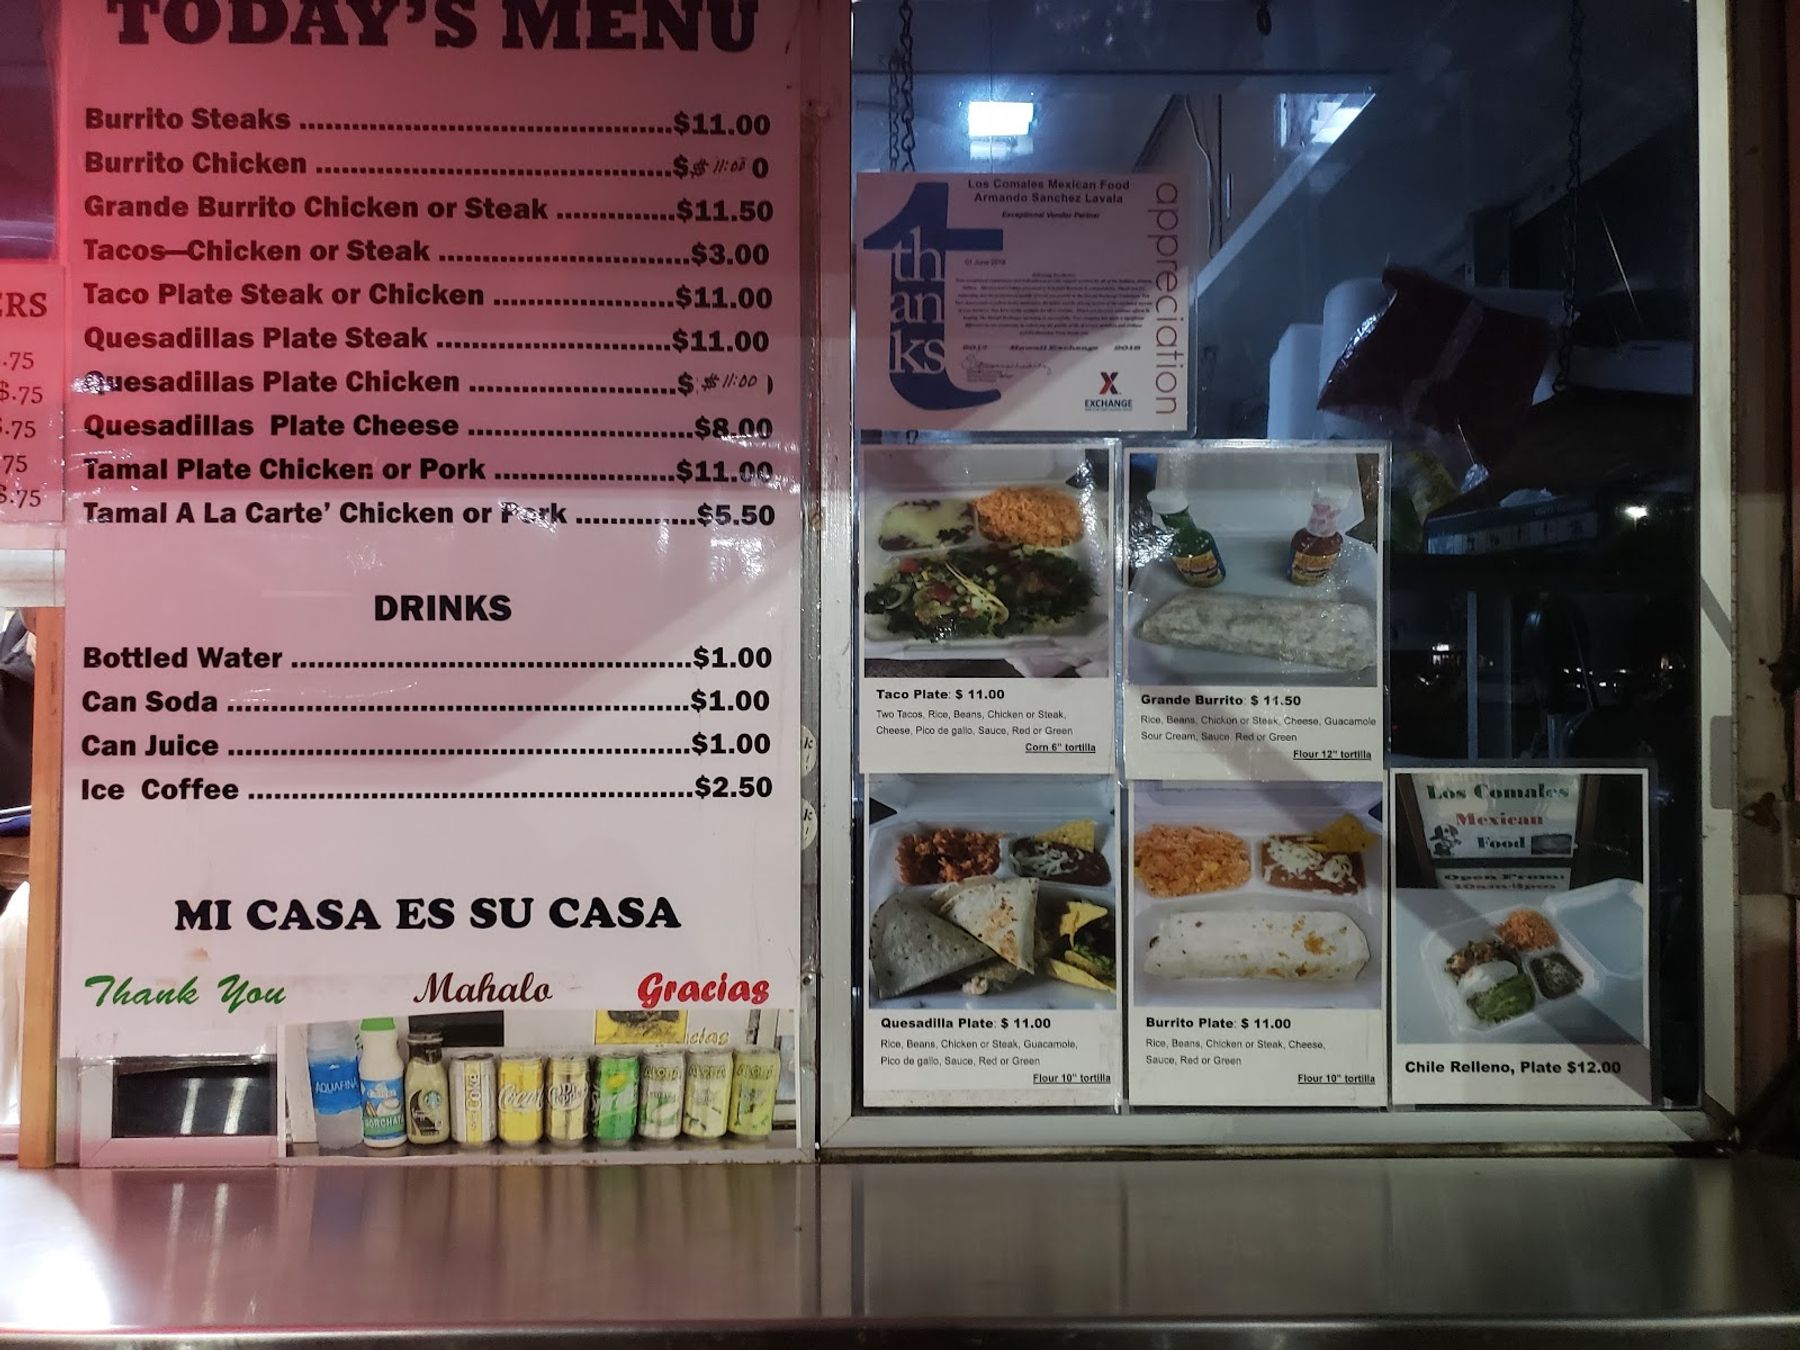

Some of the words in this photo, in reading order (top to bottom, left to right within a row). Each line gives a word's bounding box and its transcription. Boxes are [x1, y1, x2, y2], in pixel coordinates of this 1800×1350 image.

[502, 0, 758, 52] MENU
[85, 108, 183, 130] Burrito
[191, 108, 291, 130] Steaks
[673, 111, 771, 137] $11.00
[85, 152, 184, 173] Burrito
[192, 152, 306, 174] Chicken
[968, 179, 989, 189] Los
[993, 179, 1044, 189] Comales
[1048, 179, 1096, 190] Mexican
[1100, 180, 1130, 190] Food
[974, 192, 1027, 203] Armando
[1032, 193, 1080, 203] Sanchez
[84, 196, 189, 218] Grande
[199, 196, 295, 217] Burrito
[304, 197, 418, 218] Chicken
[428, 203, 457, 219] or
[465, 198, 548, 219] Steak
[676, 198, 773, 223] $11.50
[310, 246, 338, 261] or
[347, 240, 430, 262] Steak
[691, 242, 769, 266] $3.00
[84, 283, 149, 304] Taco
[158, 283, 232, 304] Plate
[240, 283, 323, 304] Steak
[331, 289, 361, 304] or
[369, 284, 484, 305] Chicken
[676, 285, 772, 309] $11.00
[1147, 182, 1184, 415] appreciation
[84, 326, 254, 351] Quesadillas
[263, 327, 337, 348] Plate
[345, 327, 427, 348] Steak
[672, 329, 769, 353] $11.00
[84, 370, 254, 395] Quesadillas
[263, 371, 337, 392] Plate
[346, 371, 459, 392] Chicken
[1084, 399, 1133, 409] EXCHANGE
[84, 414, 254, 439] Quesadillas
[271, 415, 344, 436] Plate
[353, 415, 459, 436] Cheese
[695, 415, 773, 440] $8.00
[84, 458, 167, 480] Tamal
[177, 458, 250, 480] Plate
[260, 458, 373, 480] Chicken
[383, 464, 412, 480] or
[420, 458, 486, 480] Pork
[676, 459, 773, 483] $11.00
[84, 502, 166, 524] Tamal
[176, 503, 194, 524] A
[205, 503, 236, 524] La
[340, 502, 453, 524] Chicken
[463, 509, 492, 524] or
[697, 504, 775, 528] $5.50
[374, 595, 512, 621] DRINKS
[84, 647, 188, 668] Bottled
[197, 647, 282, 668] Water
[693, 645, 772, 669] $1.00
[82, 691, 136, 712] Can
[145, 691, 217, 712] Soda
[690, 689, 769, 713] $1.00
[876, 689, 909, 699] Taco
[955, 689, 963, 700] $
[968, 689, 1005, 699] 11.00
[1141, 694, 1190, 705] Grande
[1251, 694, 1259, 706] $
[1264, 695, 1301, 706] 11.50
[876, 710, 894, 719] Two
[988, 710, 1023, 719] Chicken
[1201, 716, 1237, 725] Chicken
[1325, 717, 1376, 726] Guacamole
[82, 735, 136, 756] Can
[145, 734, 219, 756] Juice
[691, 731, 770, 756] $1.00
[1025, 743, 1048, 751] Corn
[1065, 743, 1096, 751] tortilla
[1293, 750, 1318, 759] Flour
[1340, 750, 1371, 759] tortilla
[82, 779, 124, 800] Ice
[141, 778, 239, 800] Coffee
[695, 774, 772, 799] $2.50
[1427, 785, 1466, 800] Los
[1474, 783, 1569, 799] Comales
[1456, 812, 1543, 825] Mexican
[1477, 836, 1525, 849] Food
[175, 899, 231, 930] MI
[246, 899, 381, 929] CASA
[396, 898, 455, 929] ES
[470, 898, 534, 928] SU
[549, 897, 681, 928] CASA
[85, 975, 199, 1006] Thank
[217, 974, 286, 1013] You
[413, 972, 553, 1003] Mahalo
[637, 972, 770, 1008] Gracias
[881, 1018, 953, 1029] Quesadilla
[1001, 1018, 1009, 1029] $
[1015, 1018, 1051, 1028] 11.00
[1146, 1017, 1194, 1028] Burrito
[1241, 1018, 1249, 1029] $
[1254, 1018, 1291, 1029] 11.00
[881, 1057, 900, 1065] Pico
[903, 1057, 914, 1065] de
[979, 1057, 997, 1065] Red
[1012, 1057, 1040, 1066] Green
[1181, 1056, 1198, 1065] Red
[1213, 1056, 1242, 1065] Green
[1405, 1061, 1445, 1073] Chile
[1520, 1061, 1561, 1074] Plate
[1567, 1061, 1621, 1074] $12.00
[1033, 1073, 1058, 1083] Flour
[1080, 1073, 1111, 1083] tortilla
[1298, 1074, 1322, 1083] Flour
[1344, 1074, 1375, 1083] tortilla
